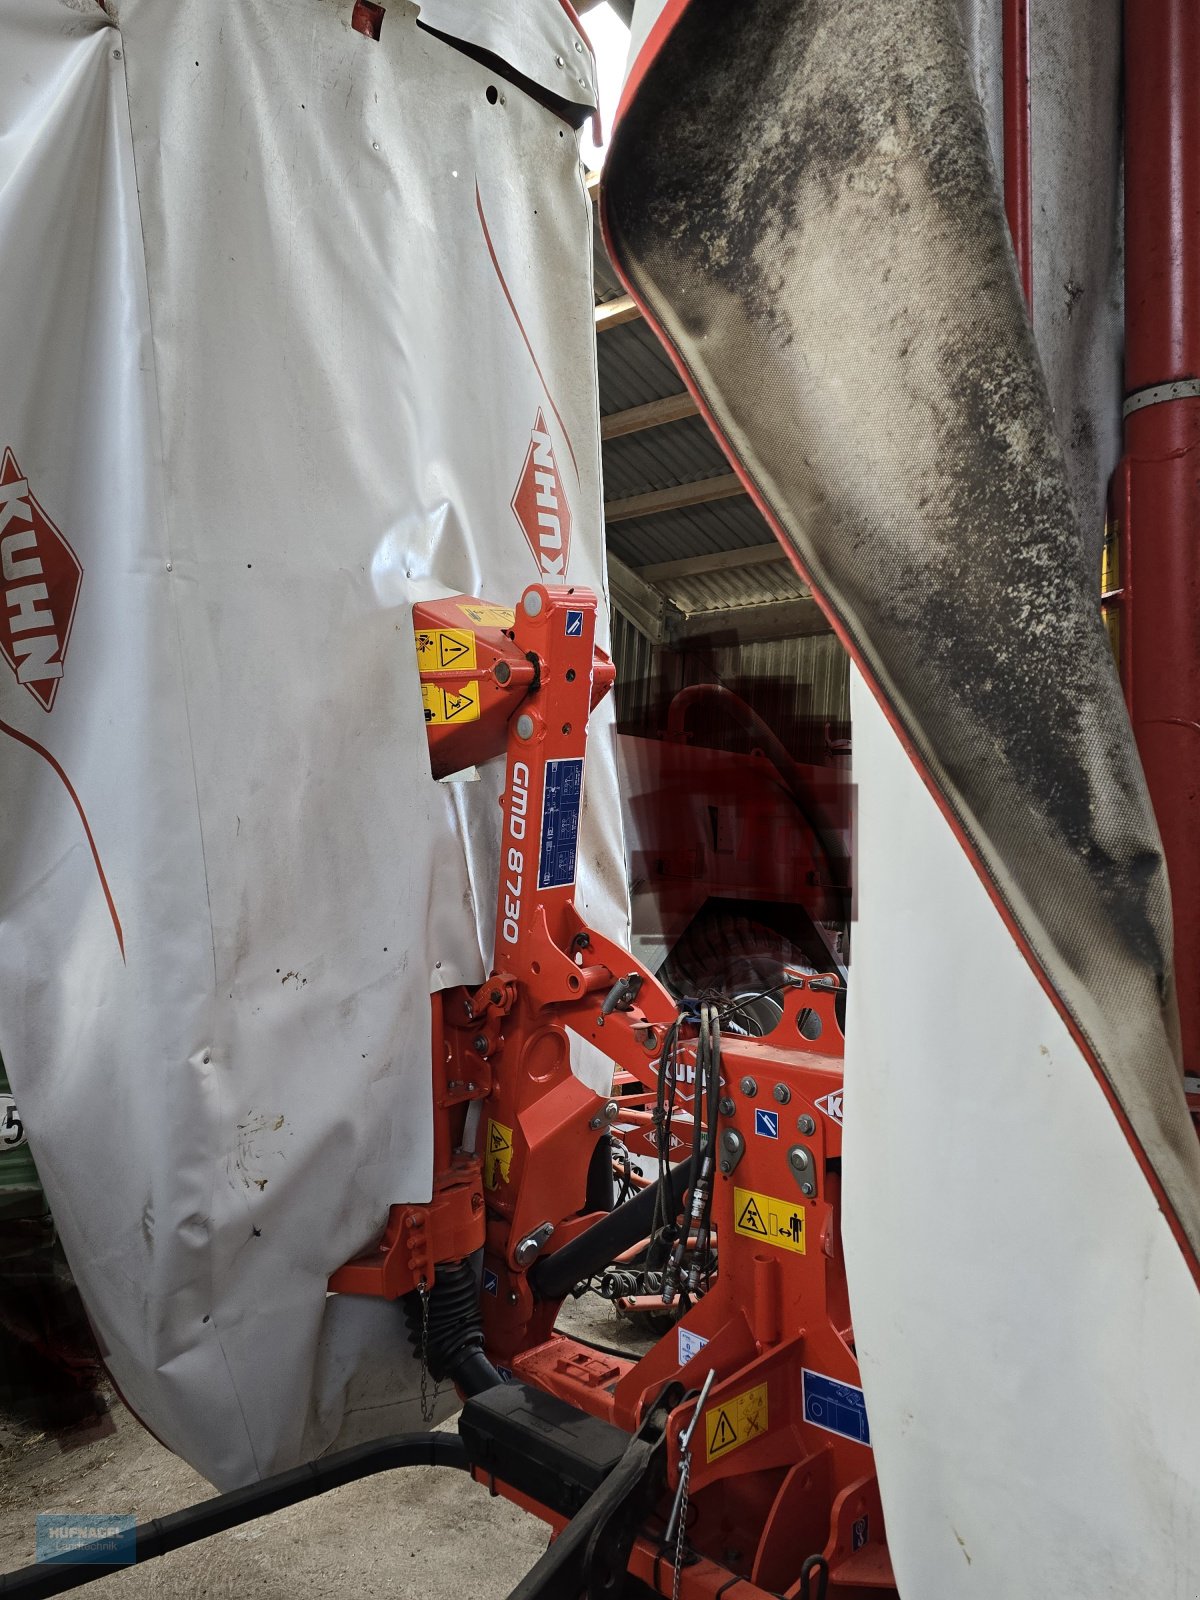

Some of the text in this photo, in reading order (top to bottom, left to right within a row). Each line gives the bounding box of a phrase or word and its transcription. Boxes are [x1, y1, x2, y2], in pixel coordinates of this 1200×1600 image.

[0, 478, 64, 684] KUHN
[530, 429, 566, 584] KUHN
[502, 761, 530, 944] GMD 8730
[664, 1060, 710, 1087] KUH
